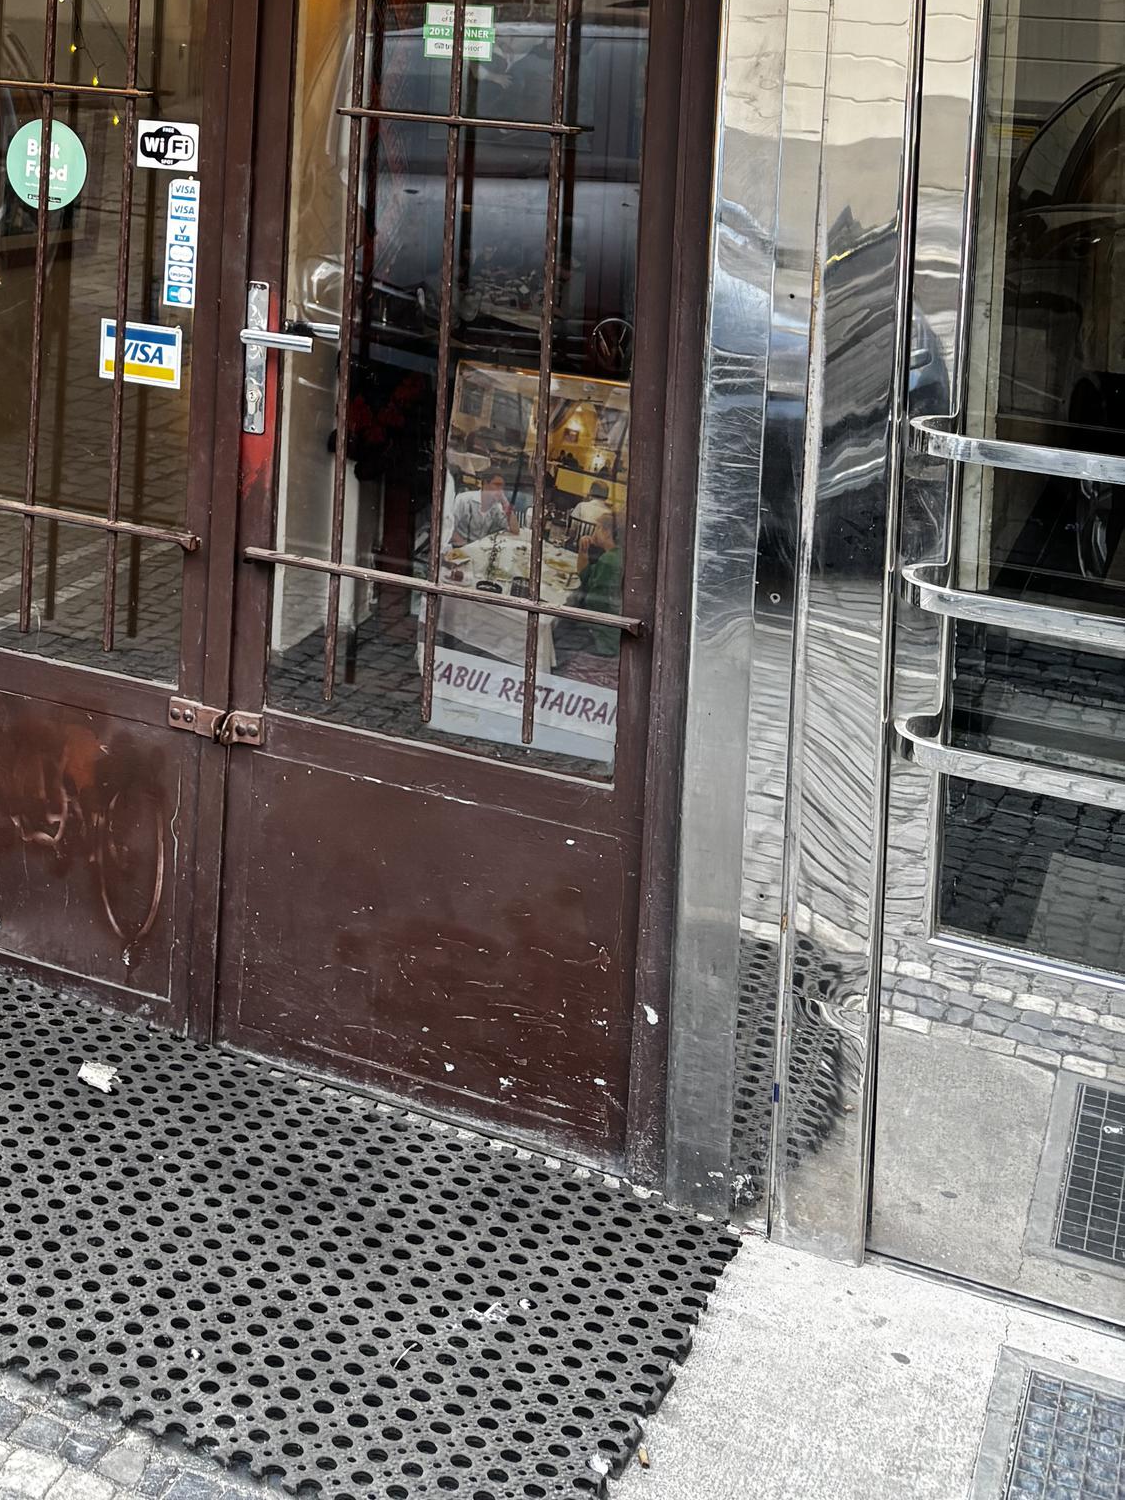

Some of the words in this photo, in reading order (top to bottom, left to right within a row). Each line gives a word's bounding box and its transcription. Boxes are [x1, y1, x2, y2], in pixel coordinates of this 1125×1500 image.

[429, 27, 450, 37] 2012
[27, 138, 60, 160] Blt
[175, 184, 196, 195] VISA
[174, 204, 195, 215] VISA
[498, 677, 617, 727] RETAURA
